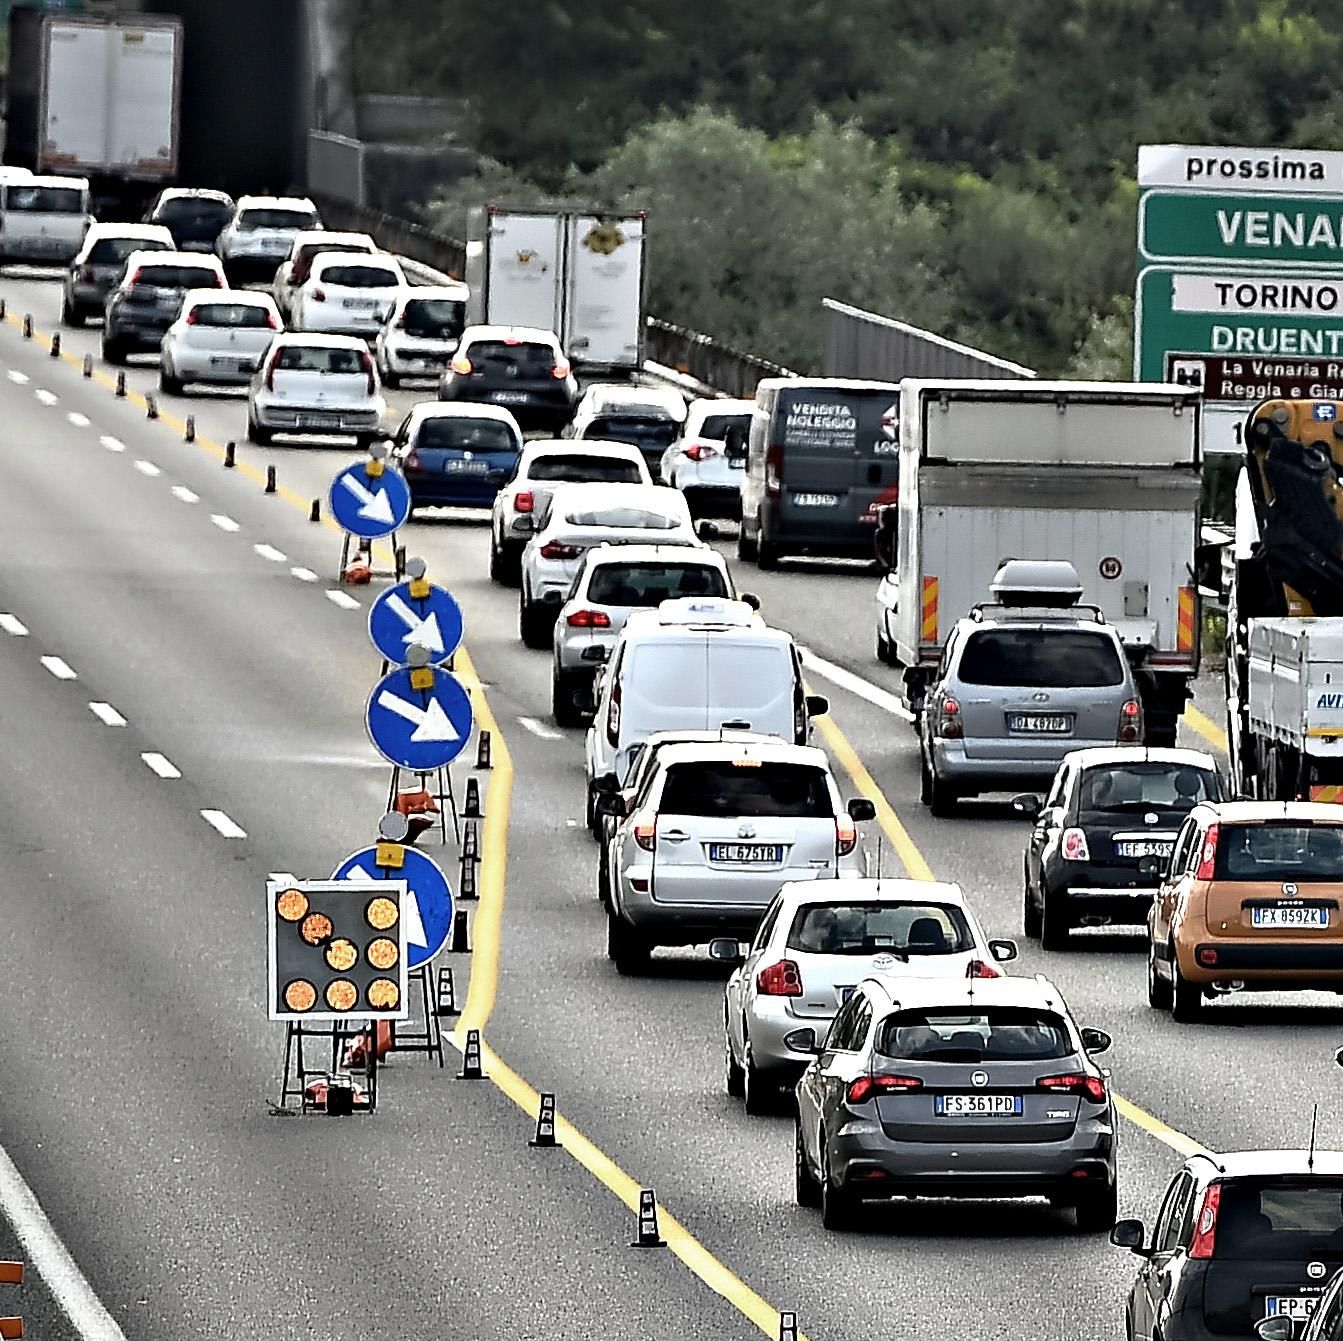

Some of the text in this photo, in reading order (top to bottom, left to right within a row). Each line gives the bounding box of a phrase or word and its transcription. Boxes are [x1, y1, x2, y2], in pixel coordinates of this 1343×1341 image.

[1186, 155, 1325, 181] prossima
[1215, 282, 1338, 311] TORINO
[1222, 360, 1243, 376] La
[1251, 361, 1319, 378] Venaria
[1221, 383, 1282, 401] Reggia
[1290, 387, 1301, 398] e
[792, 403, 851, 416] VENDITA
[786, 415, 856, 430] NOLEGGIO
[719, 846, 733, 860] EL
[1261, 909, 1276, 923] FX
[945, 1097, 1013, 1111] FS 361PD
[1279, 1299, 1298, 1315] EP
